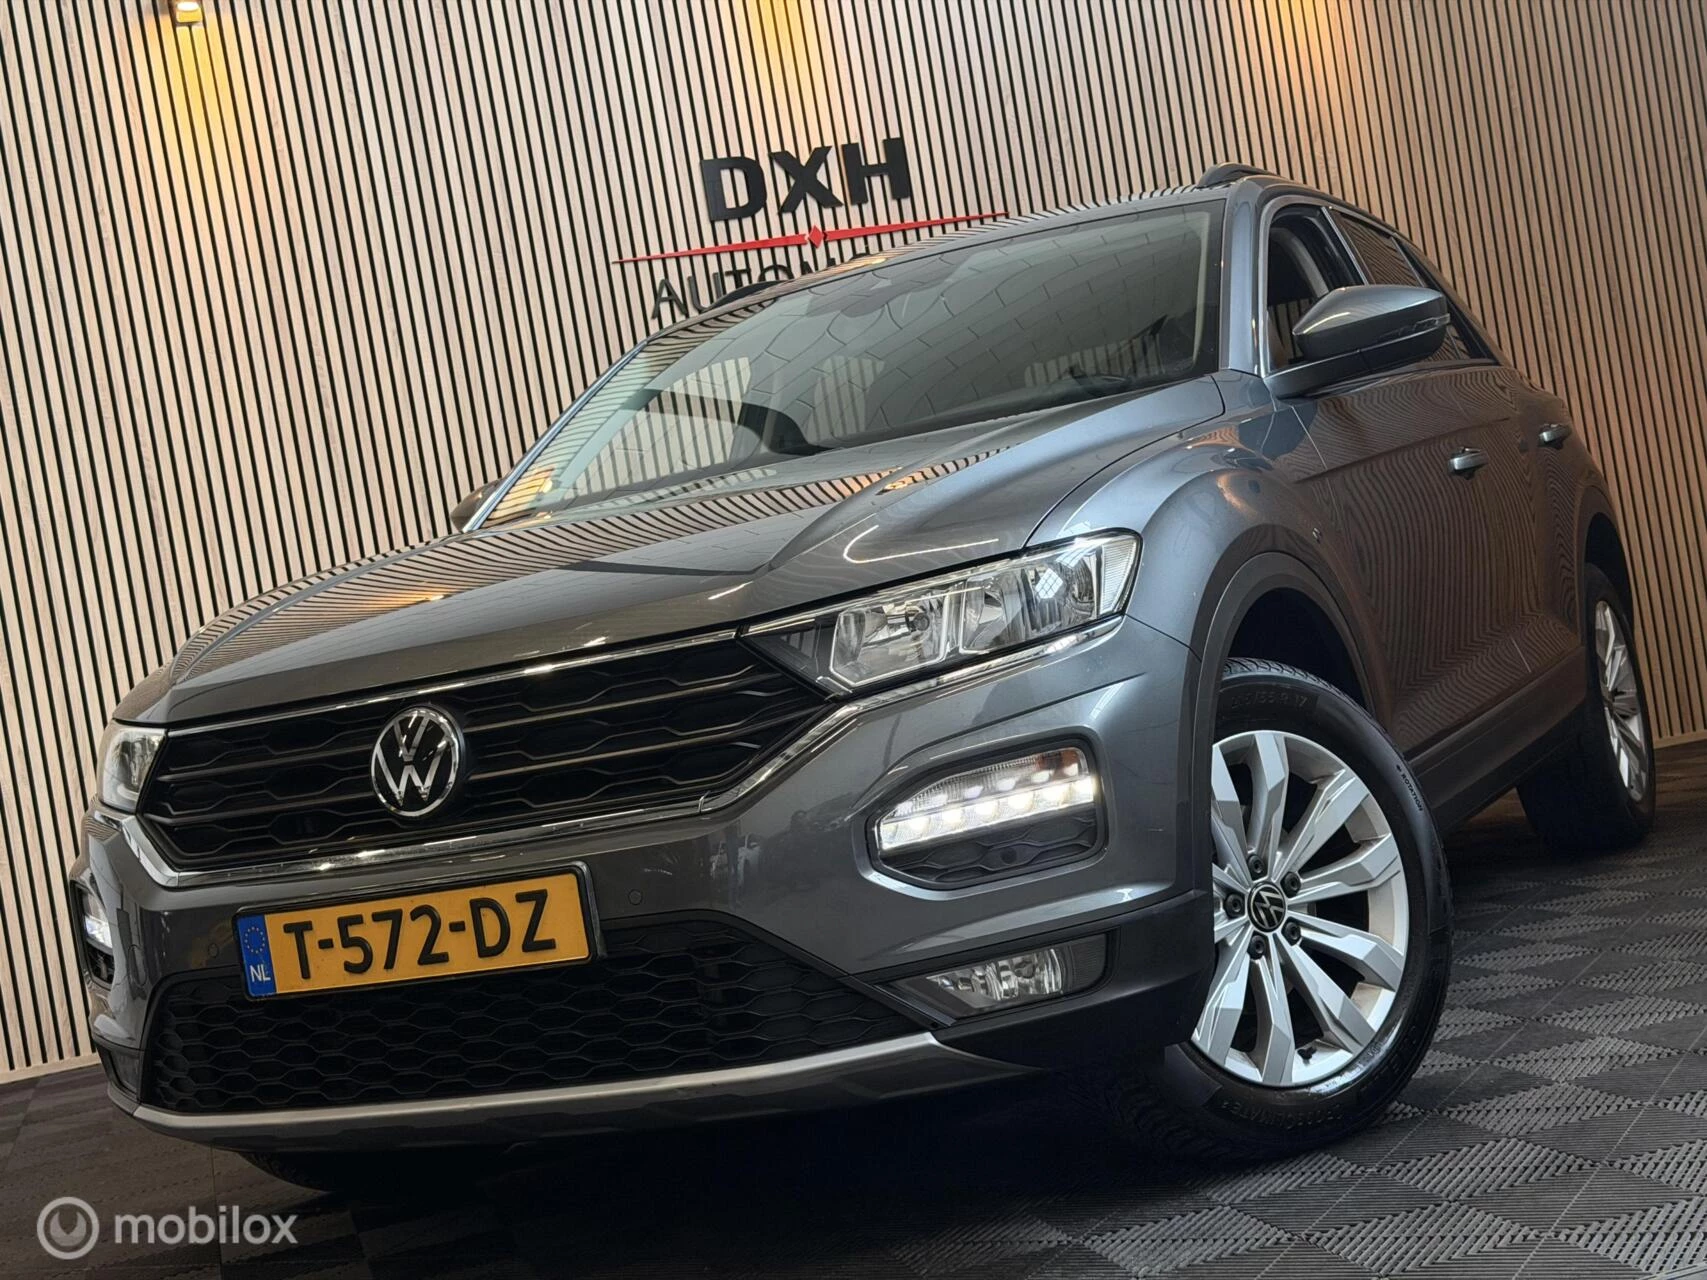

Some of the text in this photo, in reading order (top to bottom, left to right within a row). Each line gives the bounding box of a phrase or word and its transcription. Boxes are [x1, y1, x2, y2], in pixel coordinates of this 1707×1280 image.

[699, 137, 911, 222] DXH
[651, 253, 871, 320] AUTO
[283, 889, 556, 979] T-572-DZ
[250, 964, 271, 982] NL
